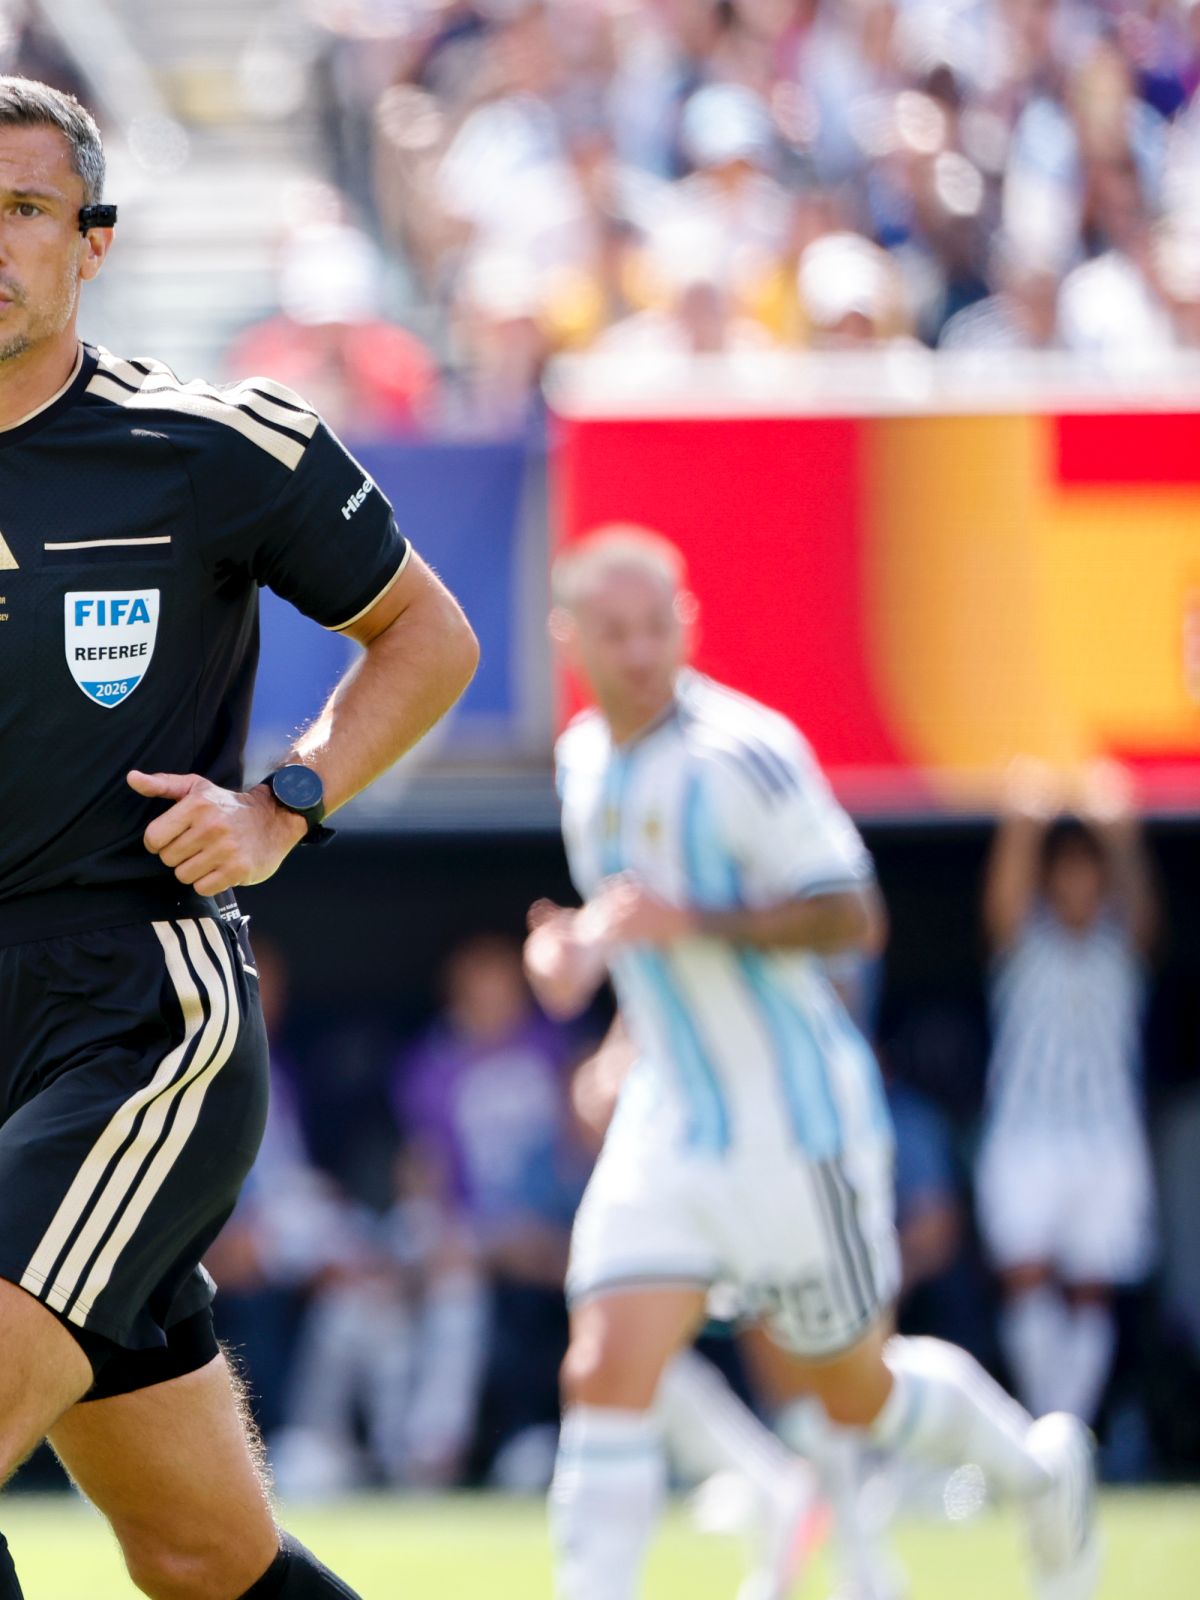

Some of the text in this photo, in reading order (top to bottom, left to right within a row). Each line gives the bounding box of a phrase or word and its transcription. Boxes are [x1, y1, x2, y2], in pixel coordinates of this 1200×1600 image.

[75, 598, 150, 627] FIFA
[75, 642, 148, 661] REFEREE
[96, 681, 128, 697] 2026
